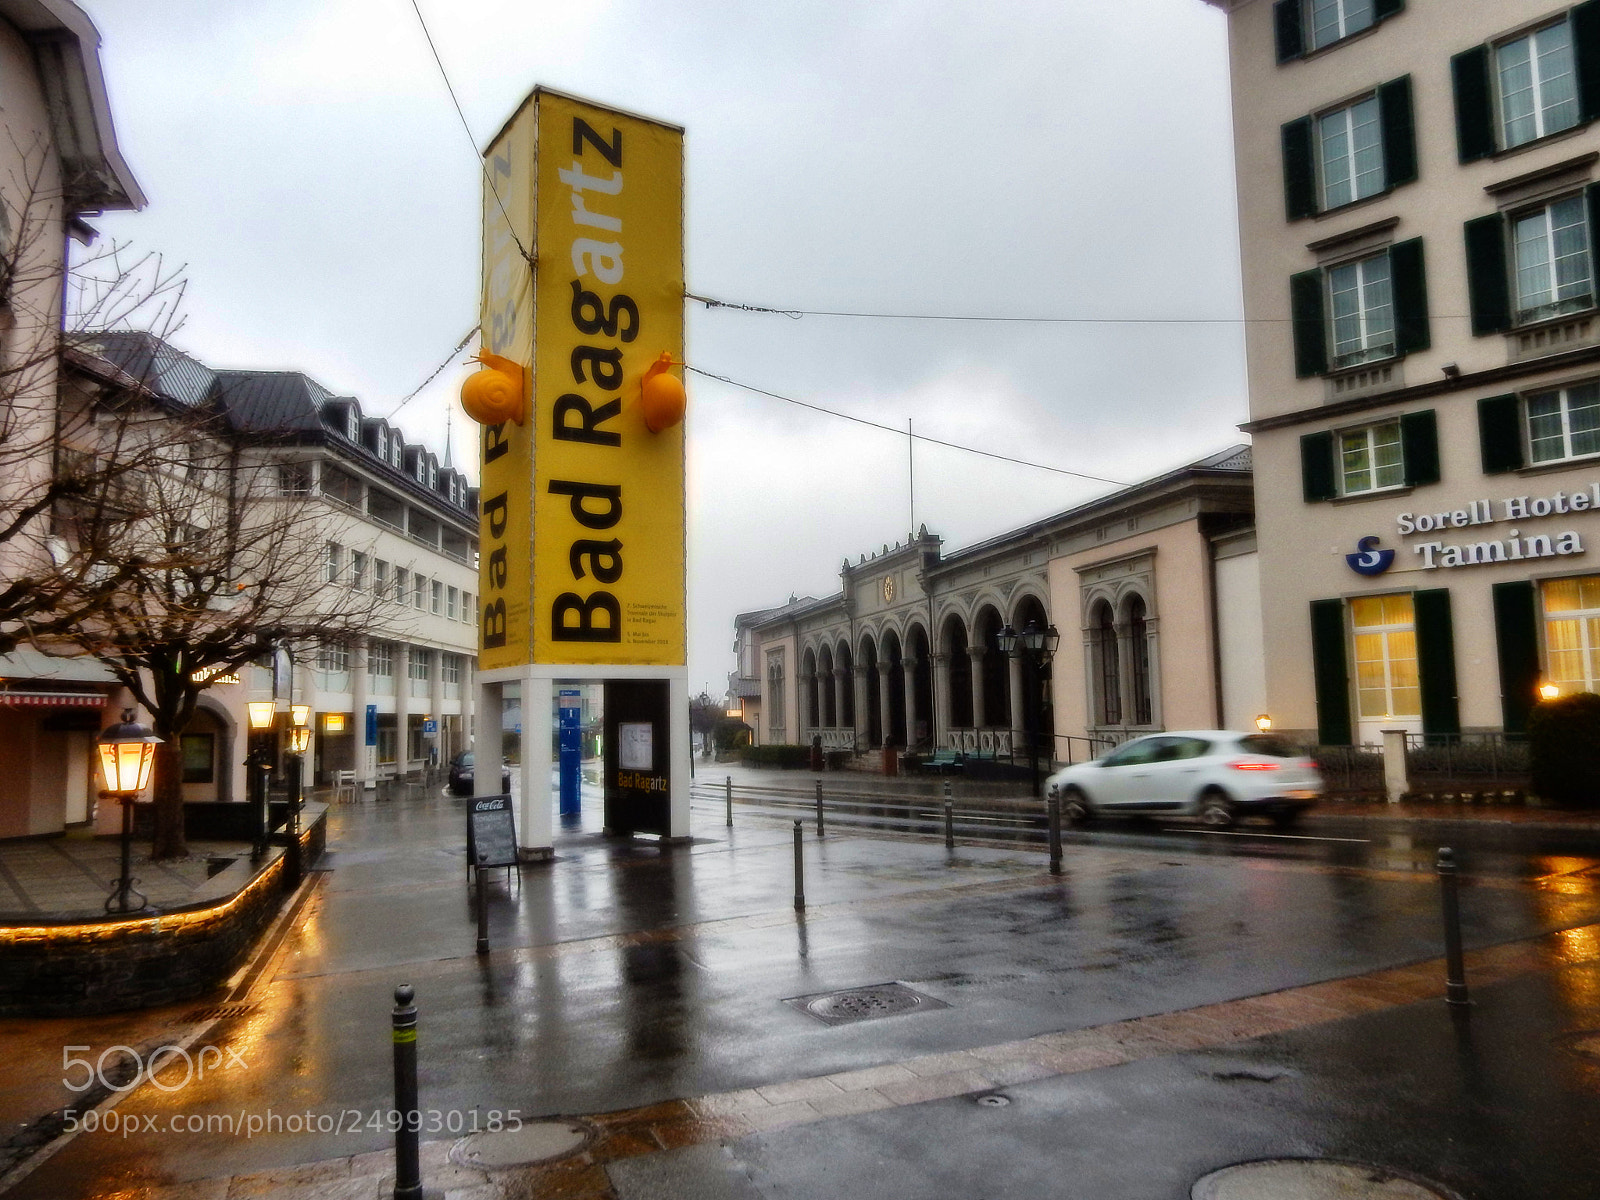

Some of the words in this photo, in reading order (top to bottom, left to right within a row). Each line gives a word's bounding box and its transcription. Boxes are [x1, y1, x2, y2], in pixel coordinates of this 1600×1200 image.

[552, 116, 640, 448] Ragartz
[548, 479, 624, 643] Bad
[1396, 499, 1493, 535] Sorell
[1503, 482, 1600, 520] Hotel
[1413, 528, 1585, 570] Tamina
[483, 490, 508, 650] Bad
[618, 772, 633, 788] Bad
[635, 772, 667, 793] Ragartz
